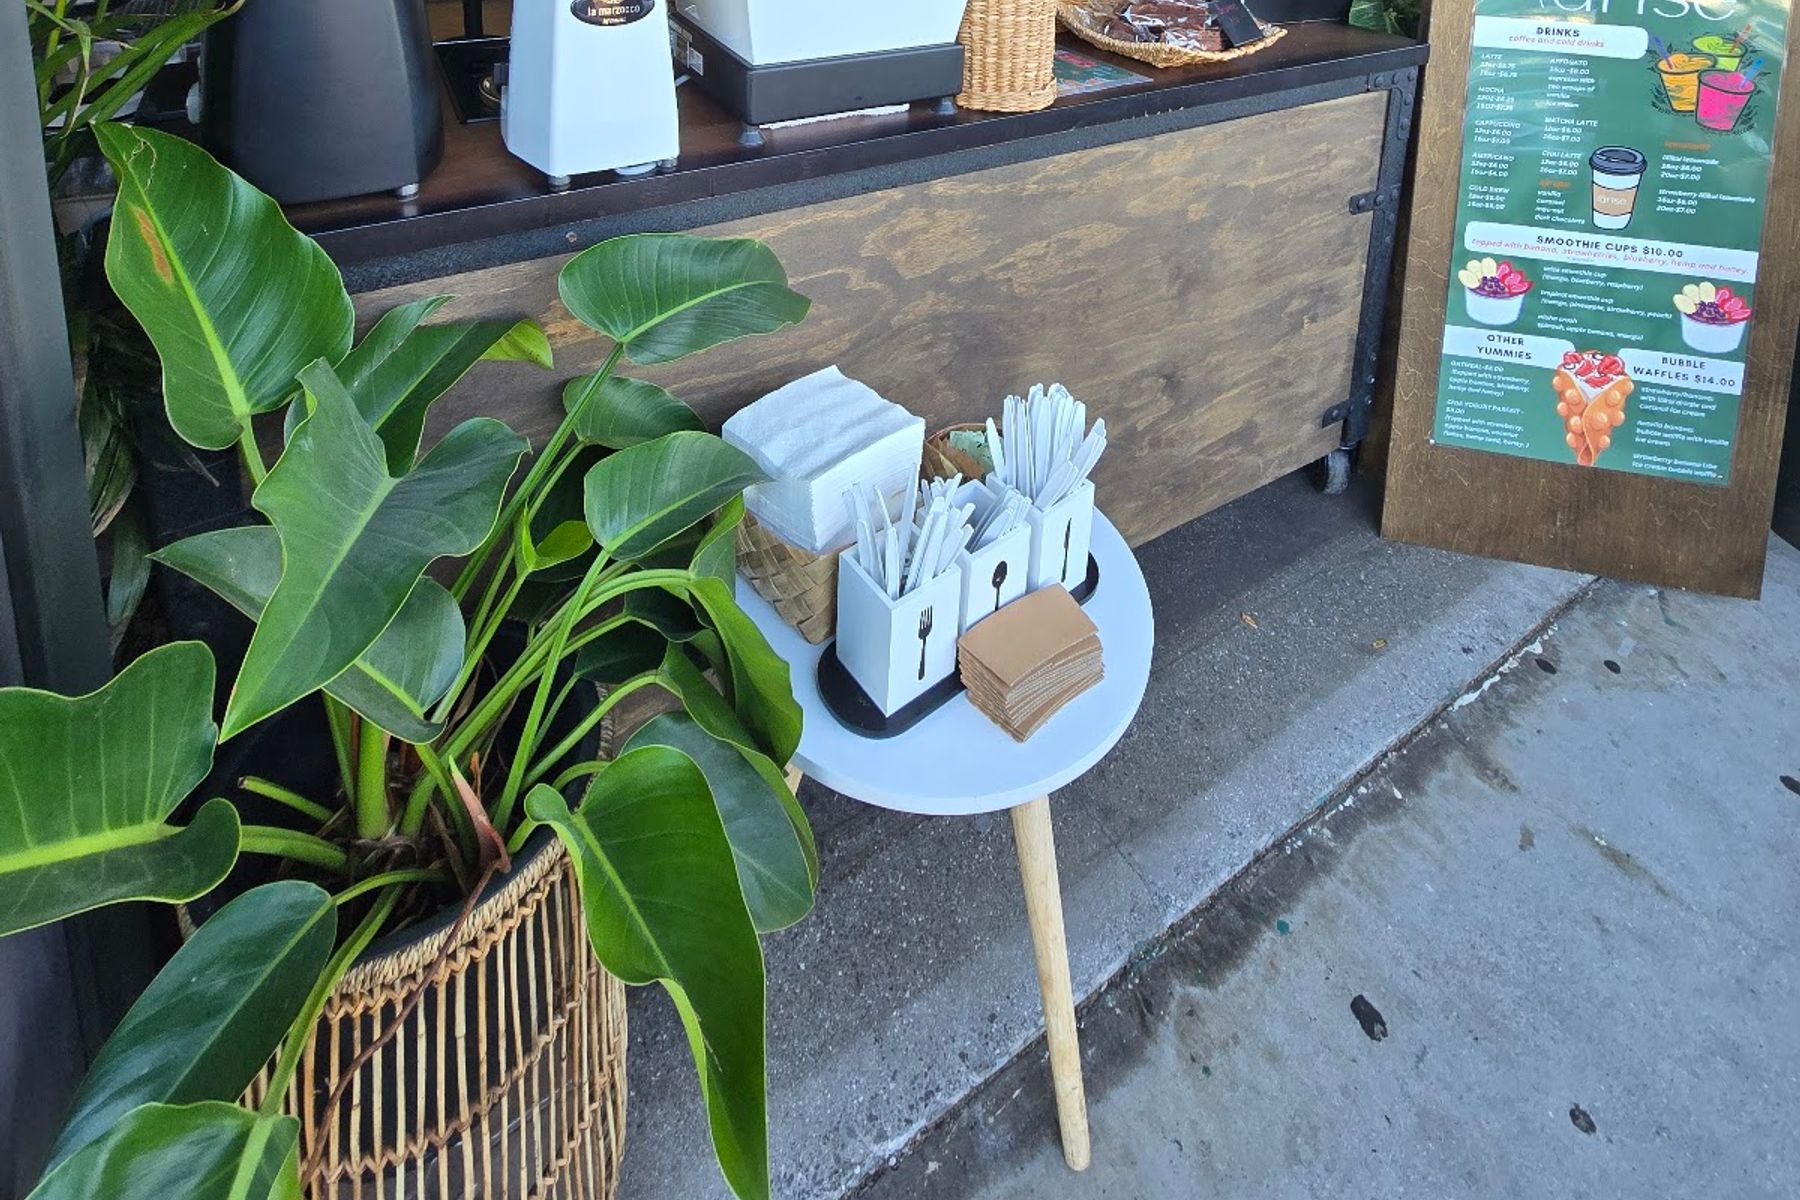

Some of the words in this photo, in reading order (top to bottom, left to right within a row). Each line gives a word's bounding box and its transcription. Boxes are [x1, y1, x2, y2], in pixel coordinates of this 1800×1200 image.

[587, 6, 597, 17] la
[598, 4, 640, 16] marzocco
[1536, 26, 1580, 38] DRINKS
[1509, 34, 1535, 43] coffee
[1537, 36, 1554, 45] and
[1556, 36, 1575, 46] cold
[1576, 38, 1605, 48] drinks
[1576, 119, 1598, 127] LATTE
[1503, 241, 1521, 249] with
[1536, 235, 1600, 250] SMOOTHIE
[1605, 243, 1638, 253] CUPS
[1642, 246, 1683, 258] $10.00
[1486, 334, 1524, 345] OTHER
[1477, 346, 1532, 360] YUMMIES
[1662, 357, 1706, 369] BUBBLE
[1633, 366, 1689, 381] WAFFLES
[1694, 374, 1736, 387] $14.00
